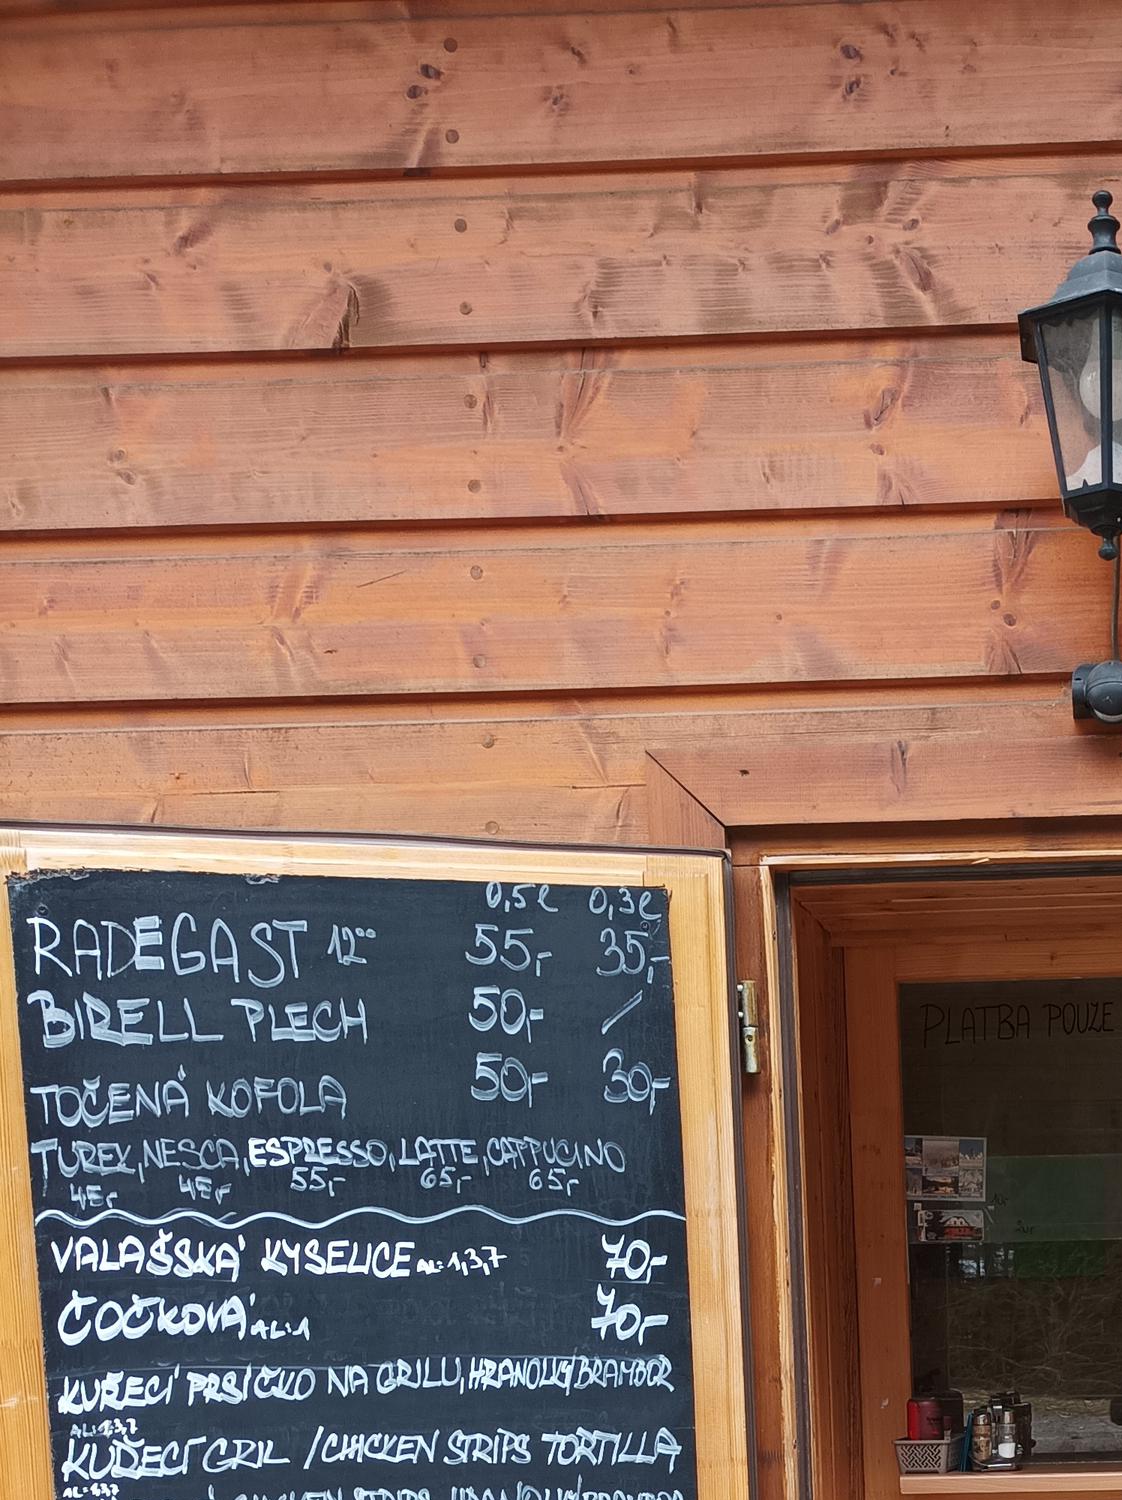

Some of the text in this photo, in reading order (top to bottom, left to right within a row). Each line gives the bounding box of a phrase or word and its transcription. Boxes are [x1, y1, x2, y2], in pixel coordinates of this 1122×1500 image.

[26, 911, 308, 988] RADEGAST
[26, 989, 225, 1049] BIRELL
[230, 995, 369, 1044] PLECH
[920, 1003, 1030, 1048] PLATBA
[1042, 1001, 1114, 1036] POUZE
[30, 1063, 191, 1129] TOČENÁ
[206, 1074, 348, 1120] KOFOLA
[51, 1228, 246, 1283] VALAŠSKÁ
[260, 1238, 416, 1279] KYSELICE
[57, 1289, 257, 1347] ČOČKOVÁ
[58, 1363, 180, 1415] KUŘECÍ
[327, 1364, 369, 1398] NA
[202, 1437, 290, 1473] GRIL
[443, 1427, 531, 1465] STRIPS
[541, 1426, 683, 1475] TORTILLA
